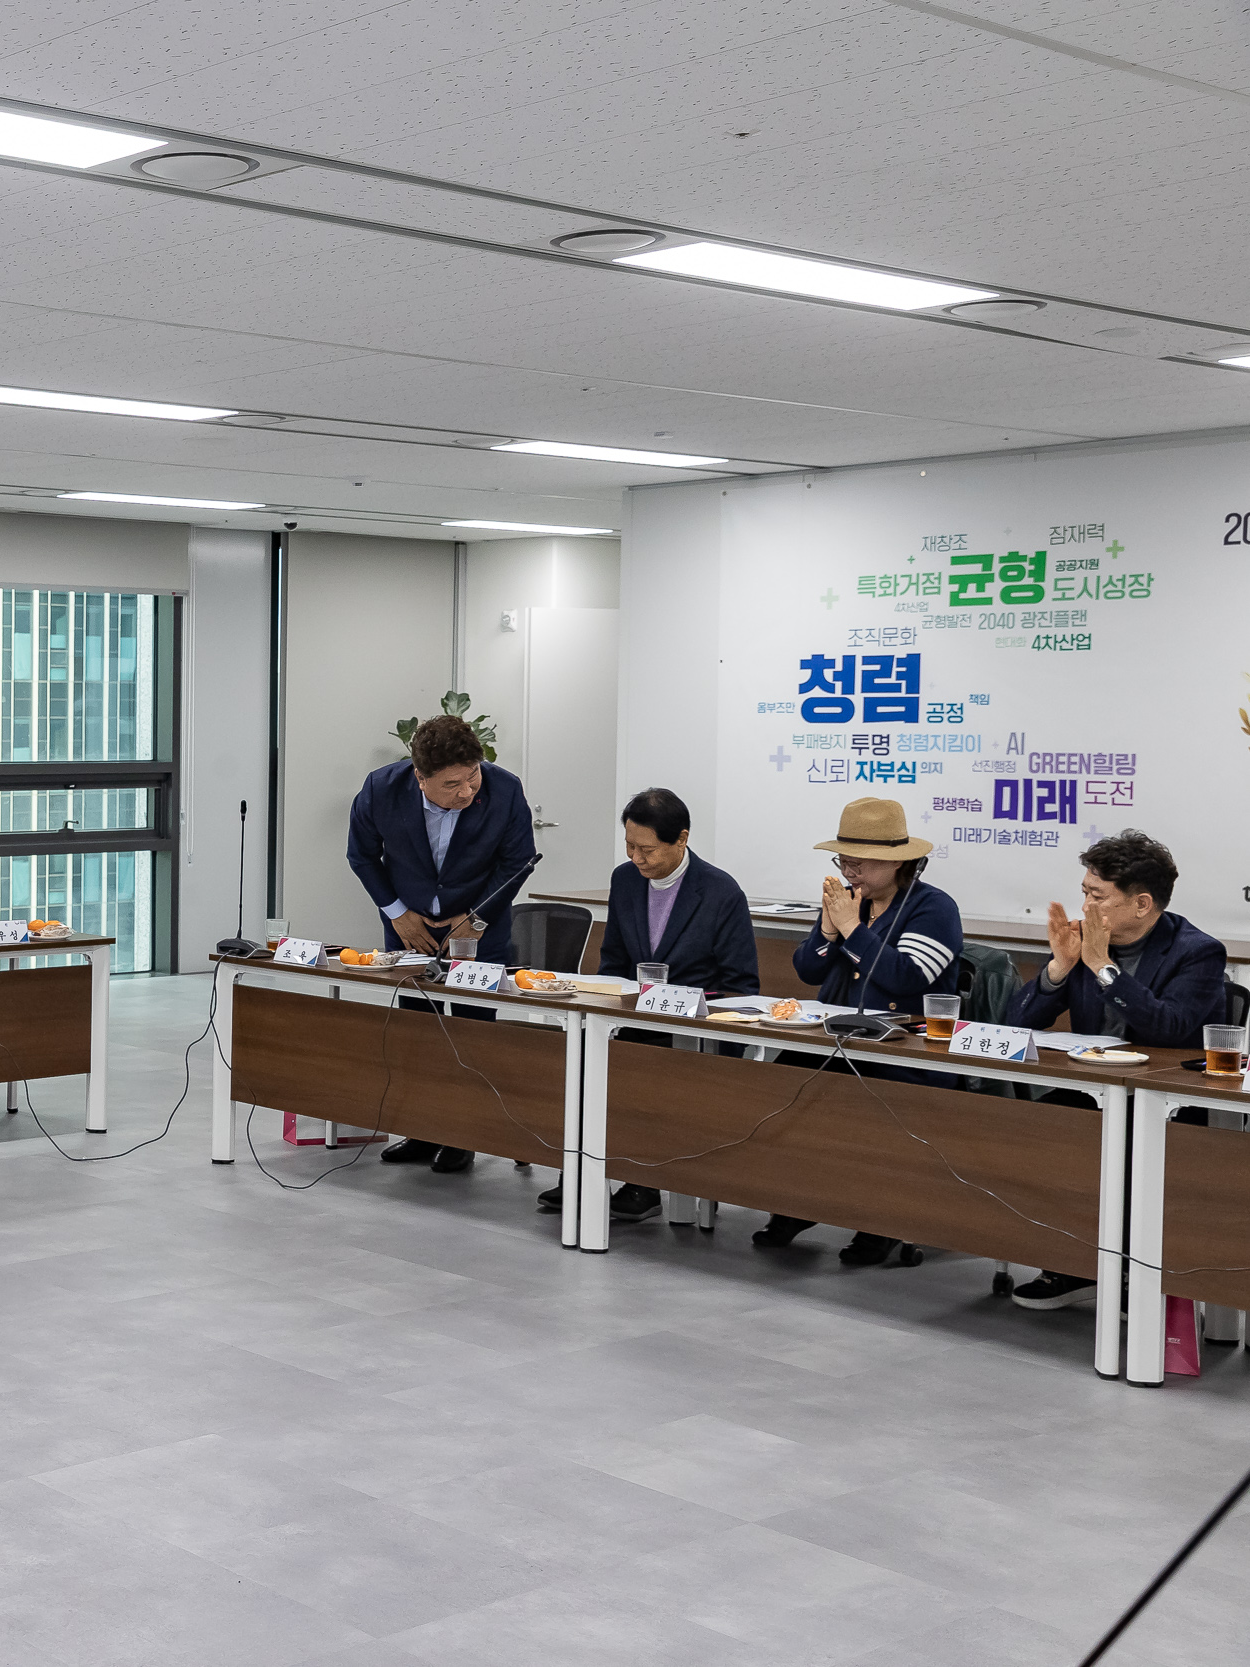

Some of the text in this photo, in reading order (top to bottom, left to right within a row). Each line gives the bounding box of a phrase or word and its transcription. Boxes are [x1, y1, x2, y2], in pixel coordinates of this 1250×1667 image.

[921, 533, 968, 552] 재창조
[1049, 523, 1105, 545] 잠재력
[1055, 559, 1100, 572] 공공지원
[857, 571, 942, 598] 특화거점
[949, 551, 1047, 607] 균형
[1051, 572, 1155, 602] 도시성장
[922, 609, 1088, 630] 균형발전 2040 광진플랜
[847, 627, 918, 648] 조직문화
[1031, 633, 1091, 651] 4차산업
[798, 653, 921, 723] 청렴
[757, 702, 796, 714] 옴부즈만
[969, 693, 990, 706] 책임
[926, 702, 964, 724] 공정
[792, 733, 847, 750] 부패방지
[851, 734, 891, 756] 투명
[897, 733, 982, 753] 청렴지킴이
[1006, 732, 1025, 755] AI
[807, 758, 850, 784] 신뢰
[855, 760, 917, 784] 자부심
[920, 761, 943, 774] 의지
[971, 759, 1017, 774] 선진행정
[1028, 752, 1137, 776] GREEN힐링
[992, 778, 1078, 825] 미래
[1083, 780, 1134, 807] 도전
[932, 797, 983, 812] 평생학습
[953, 827, 1060, 848] 미래기술체험관
[645, 997, 685, 1013] 이윤규
[960, 1035, 1010, 1055] 김한정
